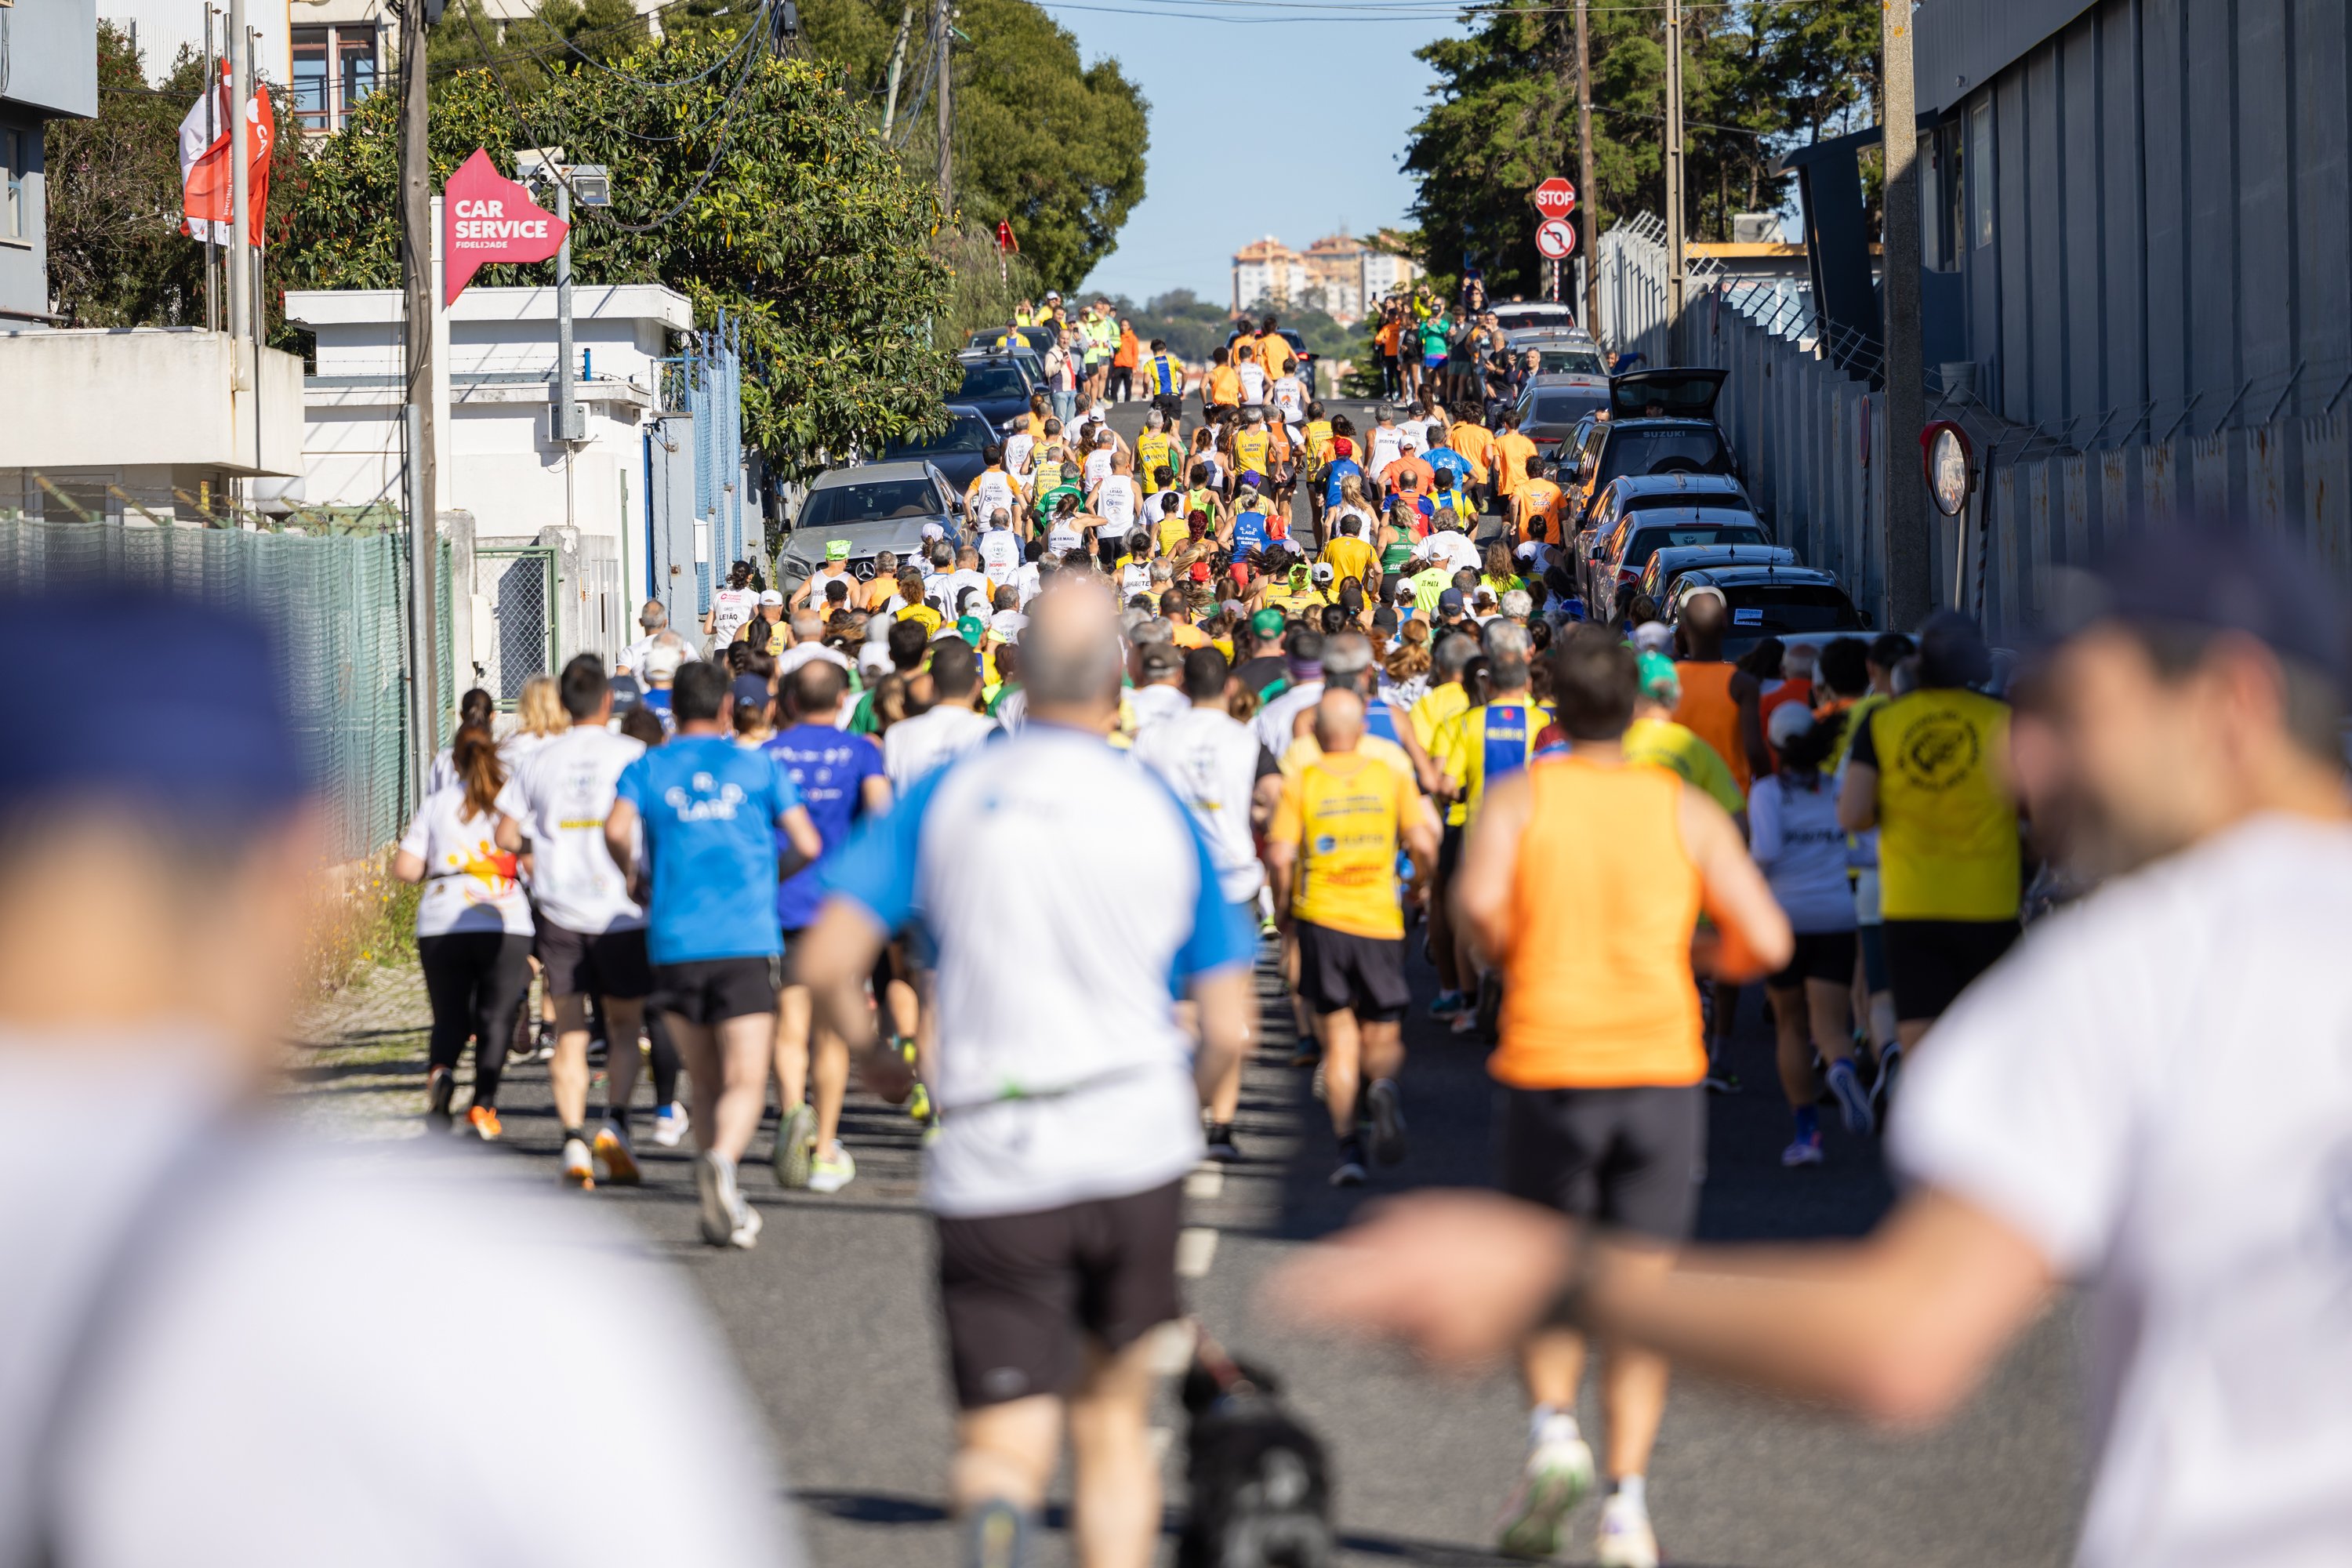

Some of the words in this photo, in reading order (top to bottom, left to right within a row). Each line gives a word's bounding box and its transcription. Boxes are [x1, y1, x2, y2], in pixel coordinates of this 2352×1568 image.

[1537, 191, 1574, 206] STOP
[455, 200, 504, 218] CAR
[455, 220, 548, 238] SERVICE
